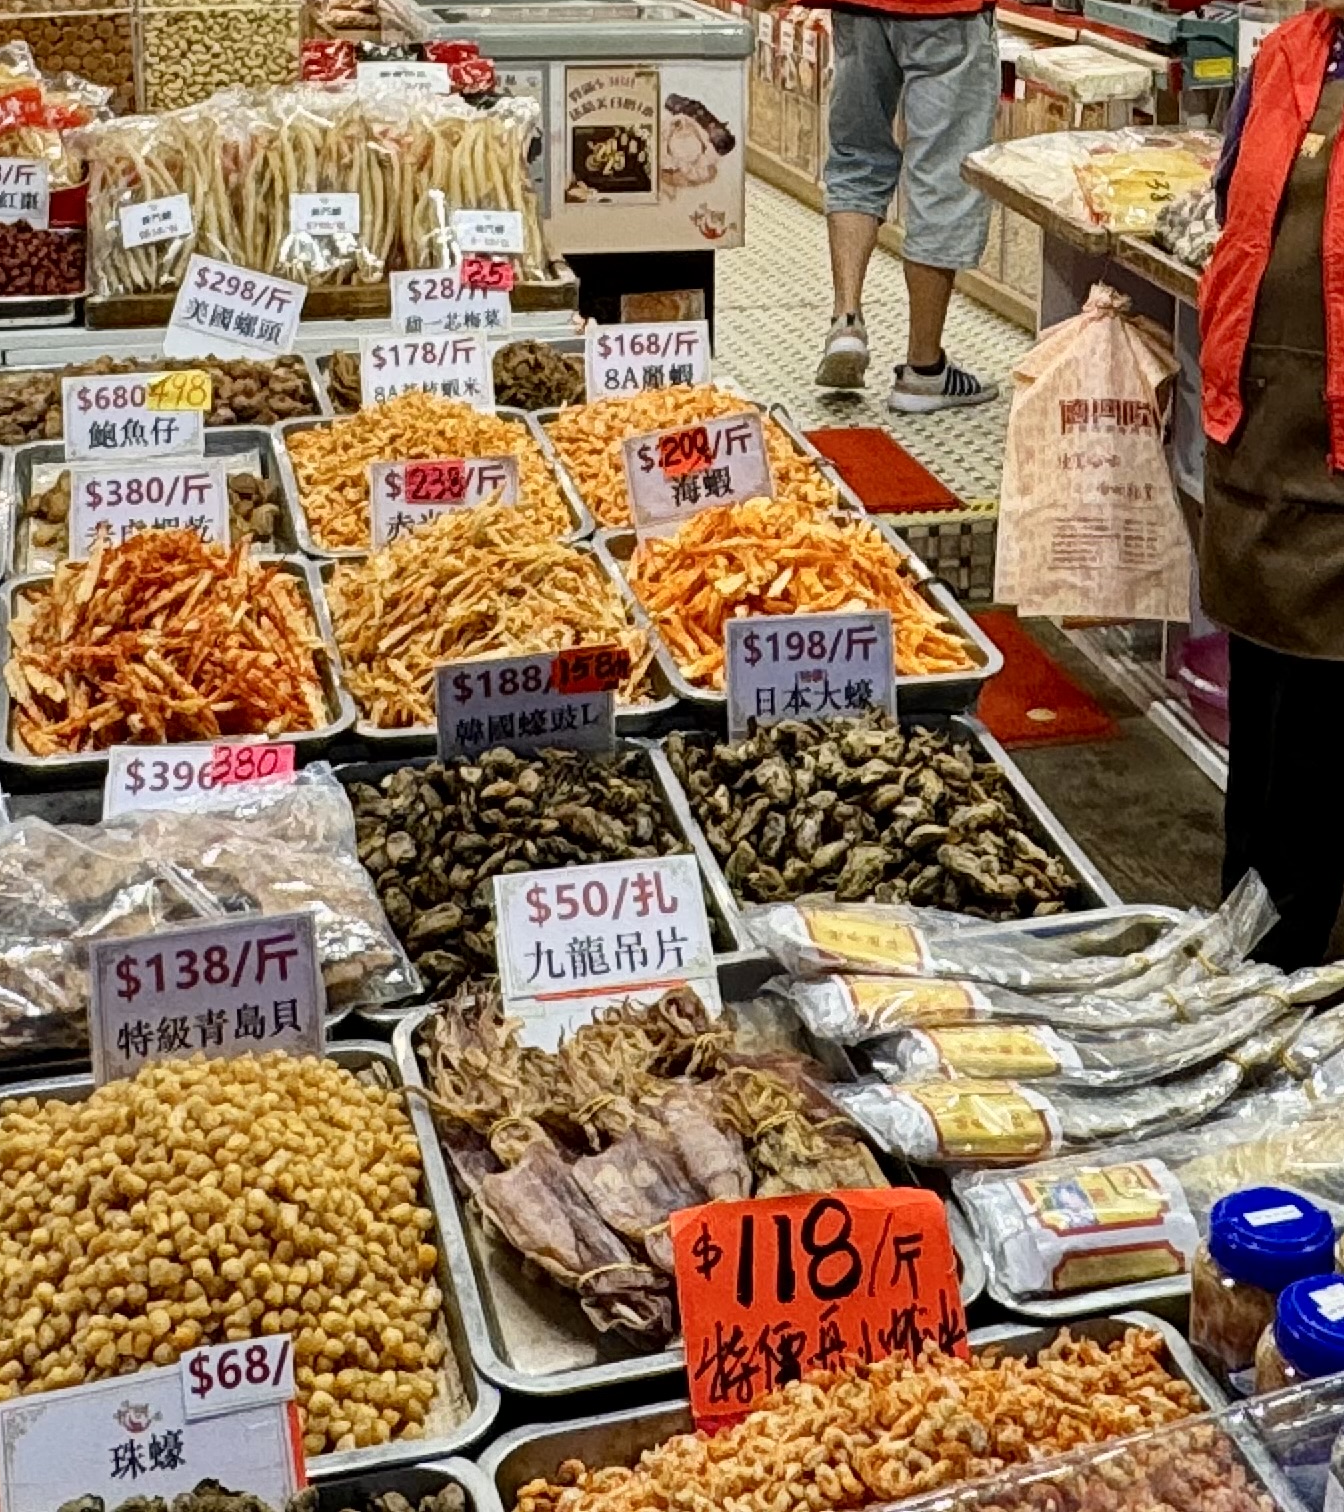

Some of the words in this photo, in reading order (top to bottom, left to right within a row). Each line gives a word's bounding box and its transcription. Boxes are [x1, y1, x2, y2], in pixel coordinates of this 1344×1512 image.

[194, 266, 293, 314] $298/斤
[371, 336, 485, 371] $178/斤
[596, 330, 700, 359] $168/斤
[88, 416, 180, 449] 鮑魚仔
[85, 473, 213, 512] $380/斤
[742, 626, 878, 668] $198/斤
[525, 870, 679, 927] $50/扎
[115, 933, 297, 1003] $138/斤
[523, 926, 689, 984] 九龍吊片
[117, 998, 303, 1060] 特級青島貝
[691, 1197, 924, 1308] $118/斤
[188, 1341, 291, 1398] $68/
[108, 1428, 188, 1480] 珠蠔
